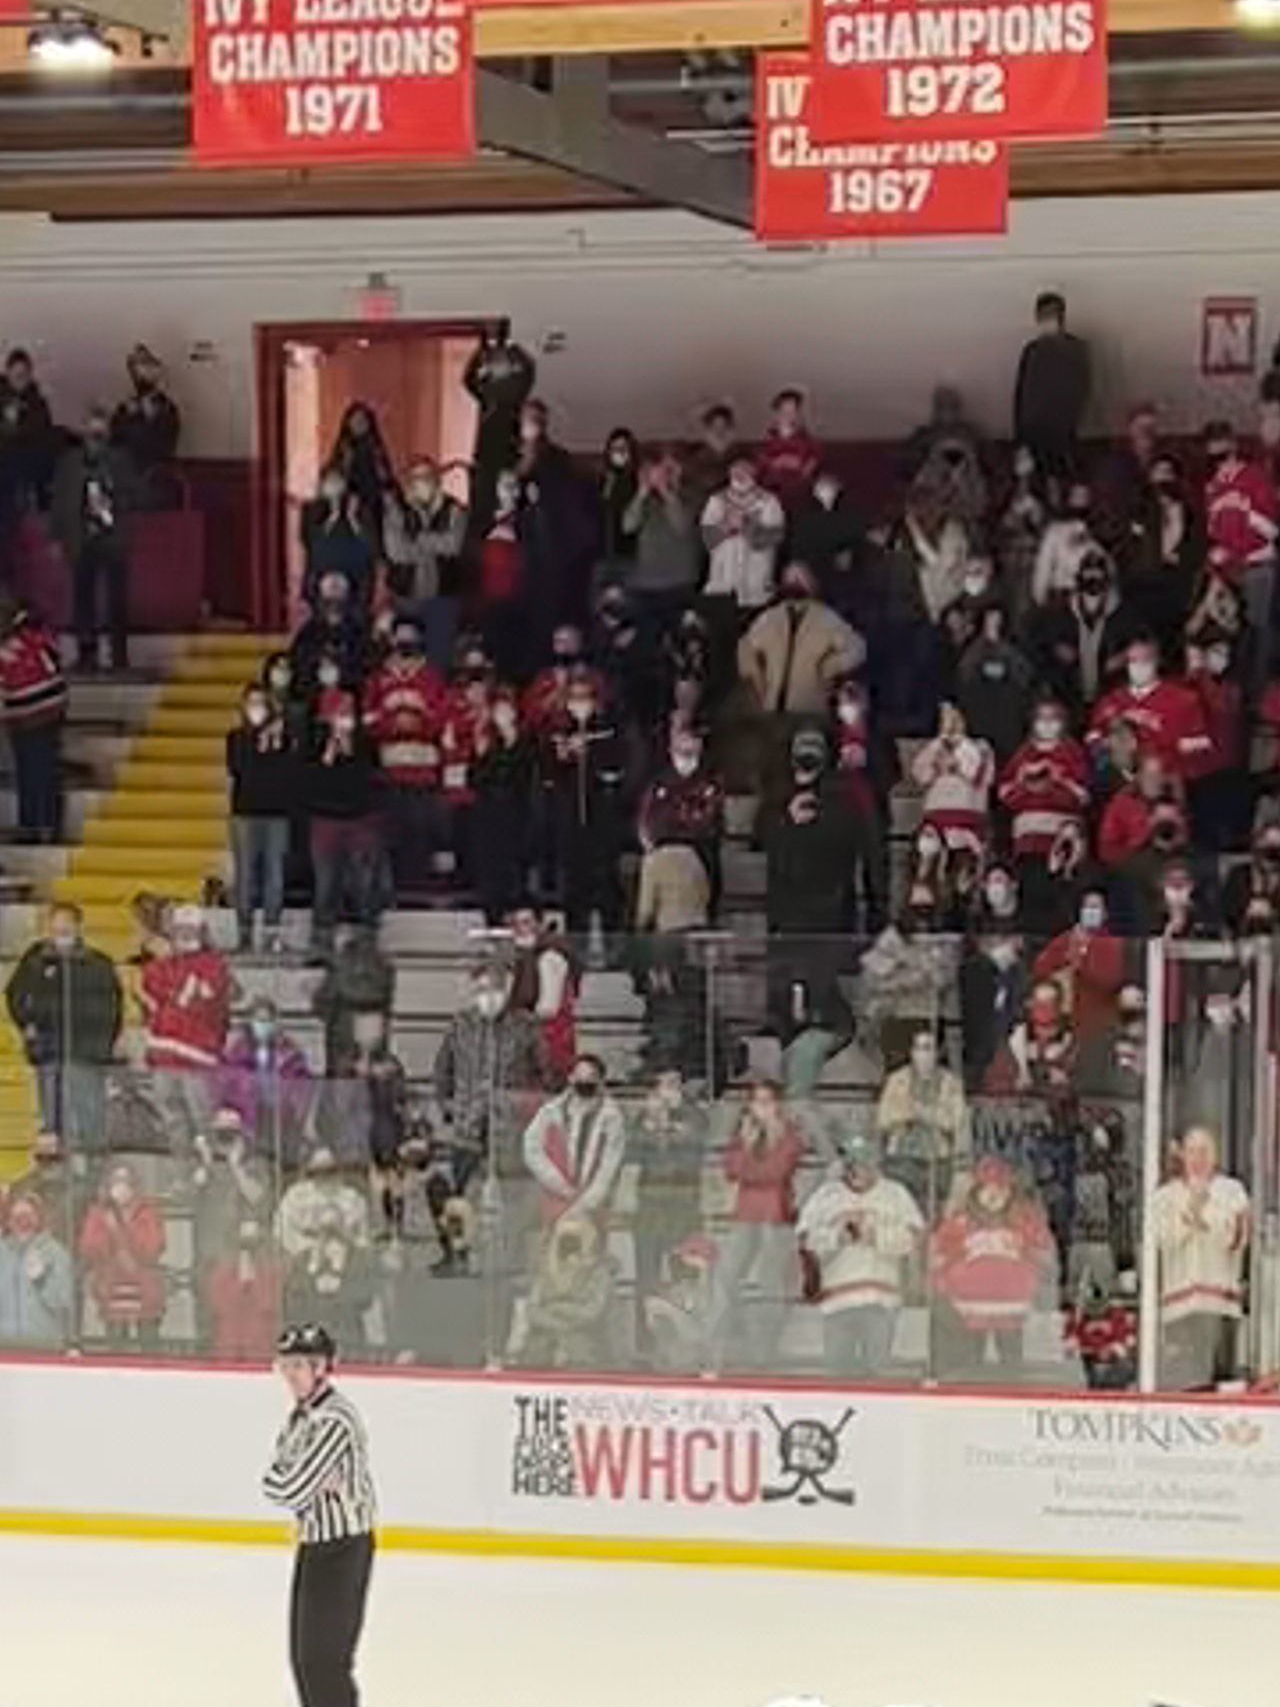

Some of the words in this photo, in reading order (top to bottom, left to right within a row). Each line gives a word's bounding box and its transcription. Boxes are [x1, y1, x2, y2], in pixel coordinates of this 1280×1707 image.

[207, 26, 461, 85] CHAMPIONS
[824, 1, 1094, 66] CHAMPIONS
[285, 86, 382, 136] 1971
[885, 65, 1005, 117] 1972
[828, 169, 933, 213] 1967
[513, 1396, 569, 1439] THE
[1028, 1407, 1221, 1451] TOMPKINS
[575, 1423, 761, 1505] WHCU
